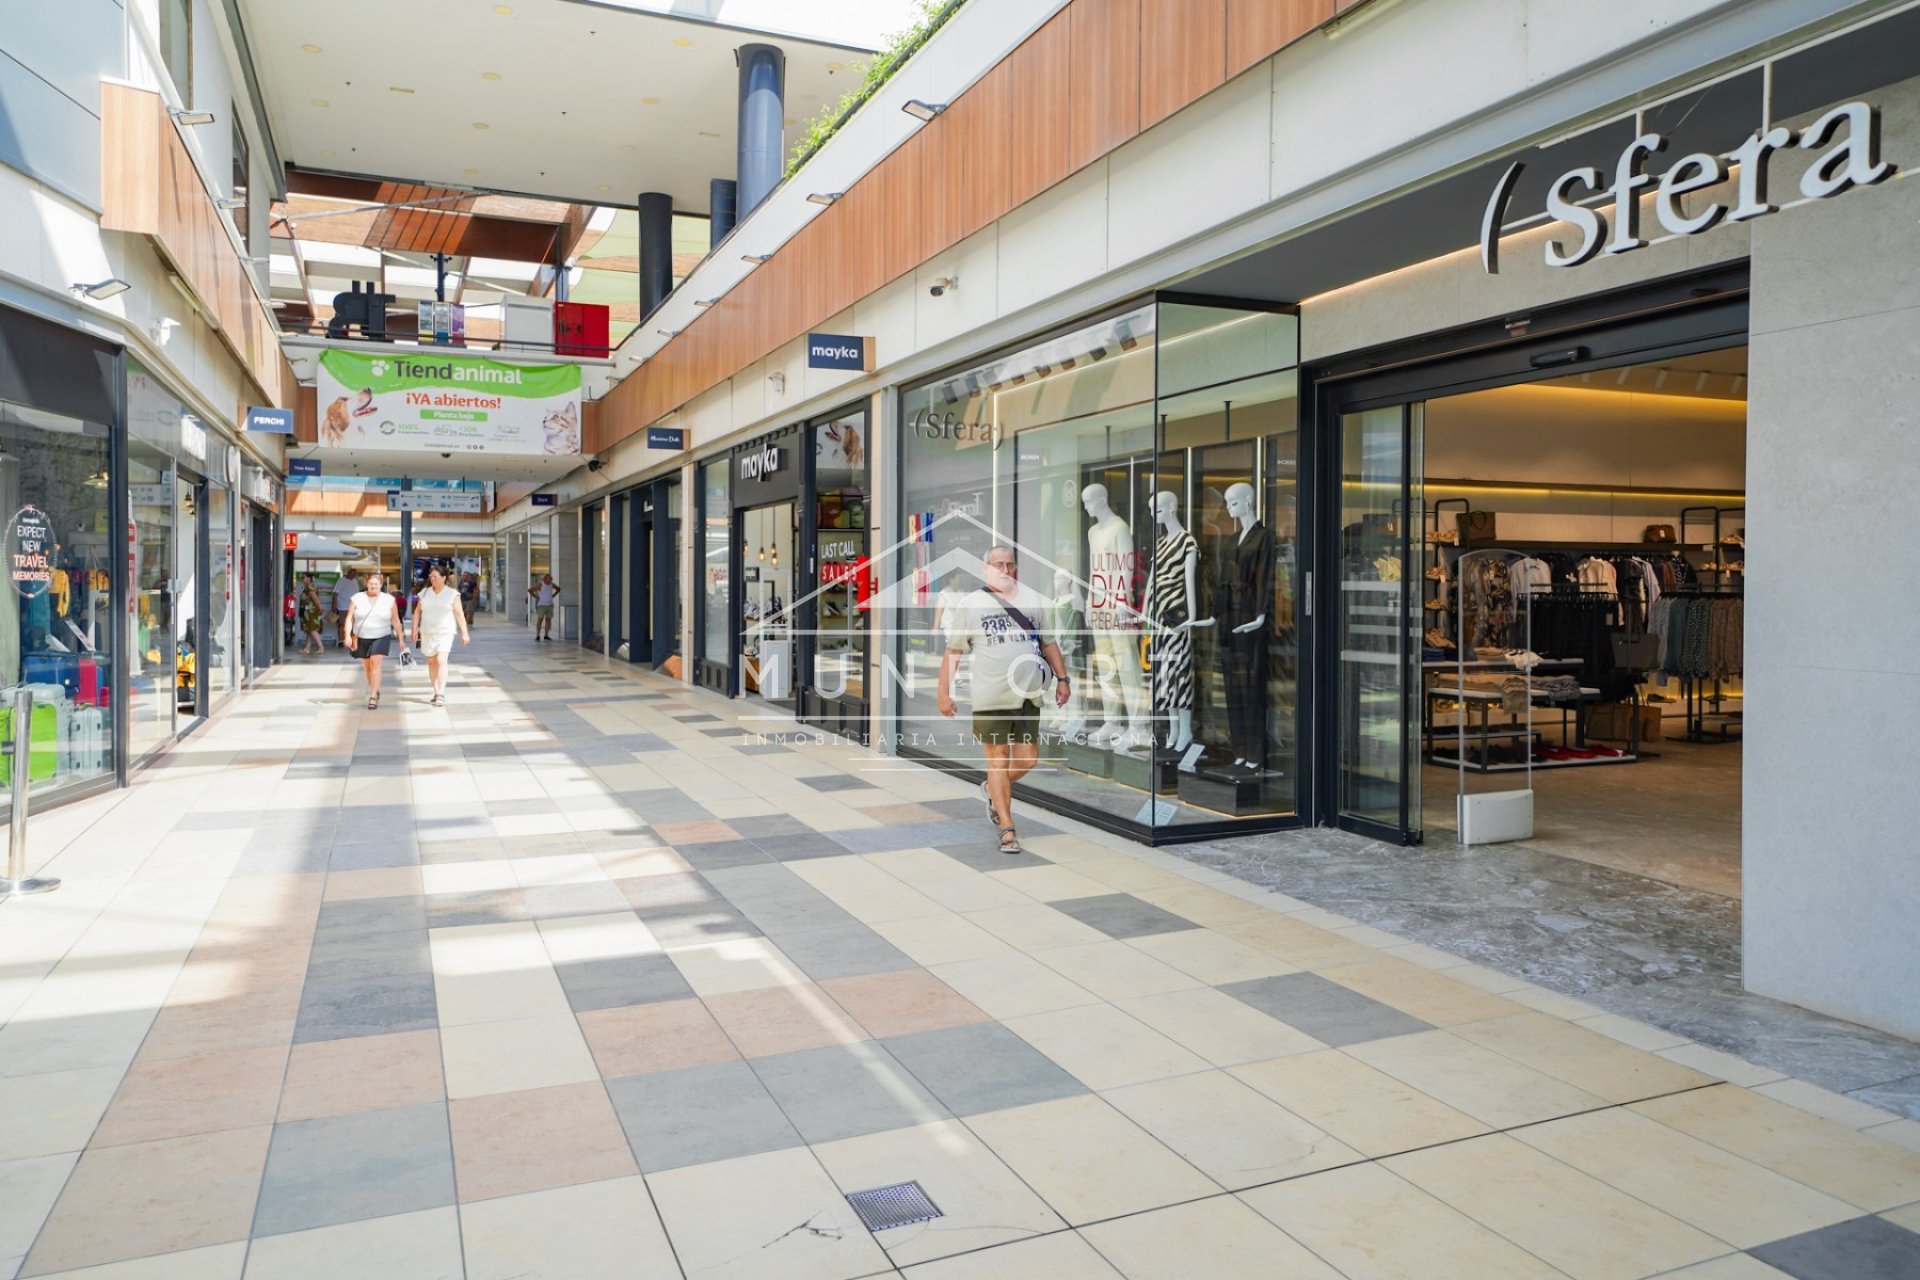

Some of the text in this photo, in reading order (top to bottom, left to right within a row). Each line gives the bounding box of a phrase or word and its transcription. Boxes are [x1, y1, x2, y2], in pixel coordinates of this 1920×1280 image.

[812, 345, 859, 360] mayka
[394, 360, 522, 385] Tiendanimal
[406, 393, 501, 409] ¡YA abiertos!
[254, 416, 285, 426] FERCHI
[433, 411, 475, 421] Planta baja
[914, 408, 1004, 451] (Sfera)
[741, 443, 779, 482] mayka
[17, 526, 47, 539] EXPECT
[22, 540, 41, 552] NEW
[821, 540, 855, 559] LAST CALL
[13, 554, 49, 568] TRAVEL
[13, 571, 50, 581] MEMORIES
[822, 565, 858, 581] SALES
